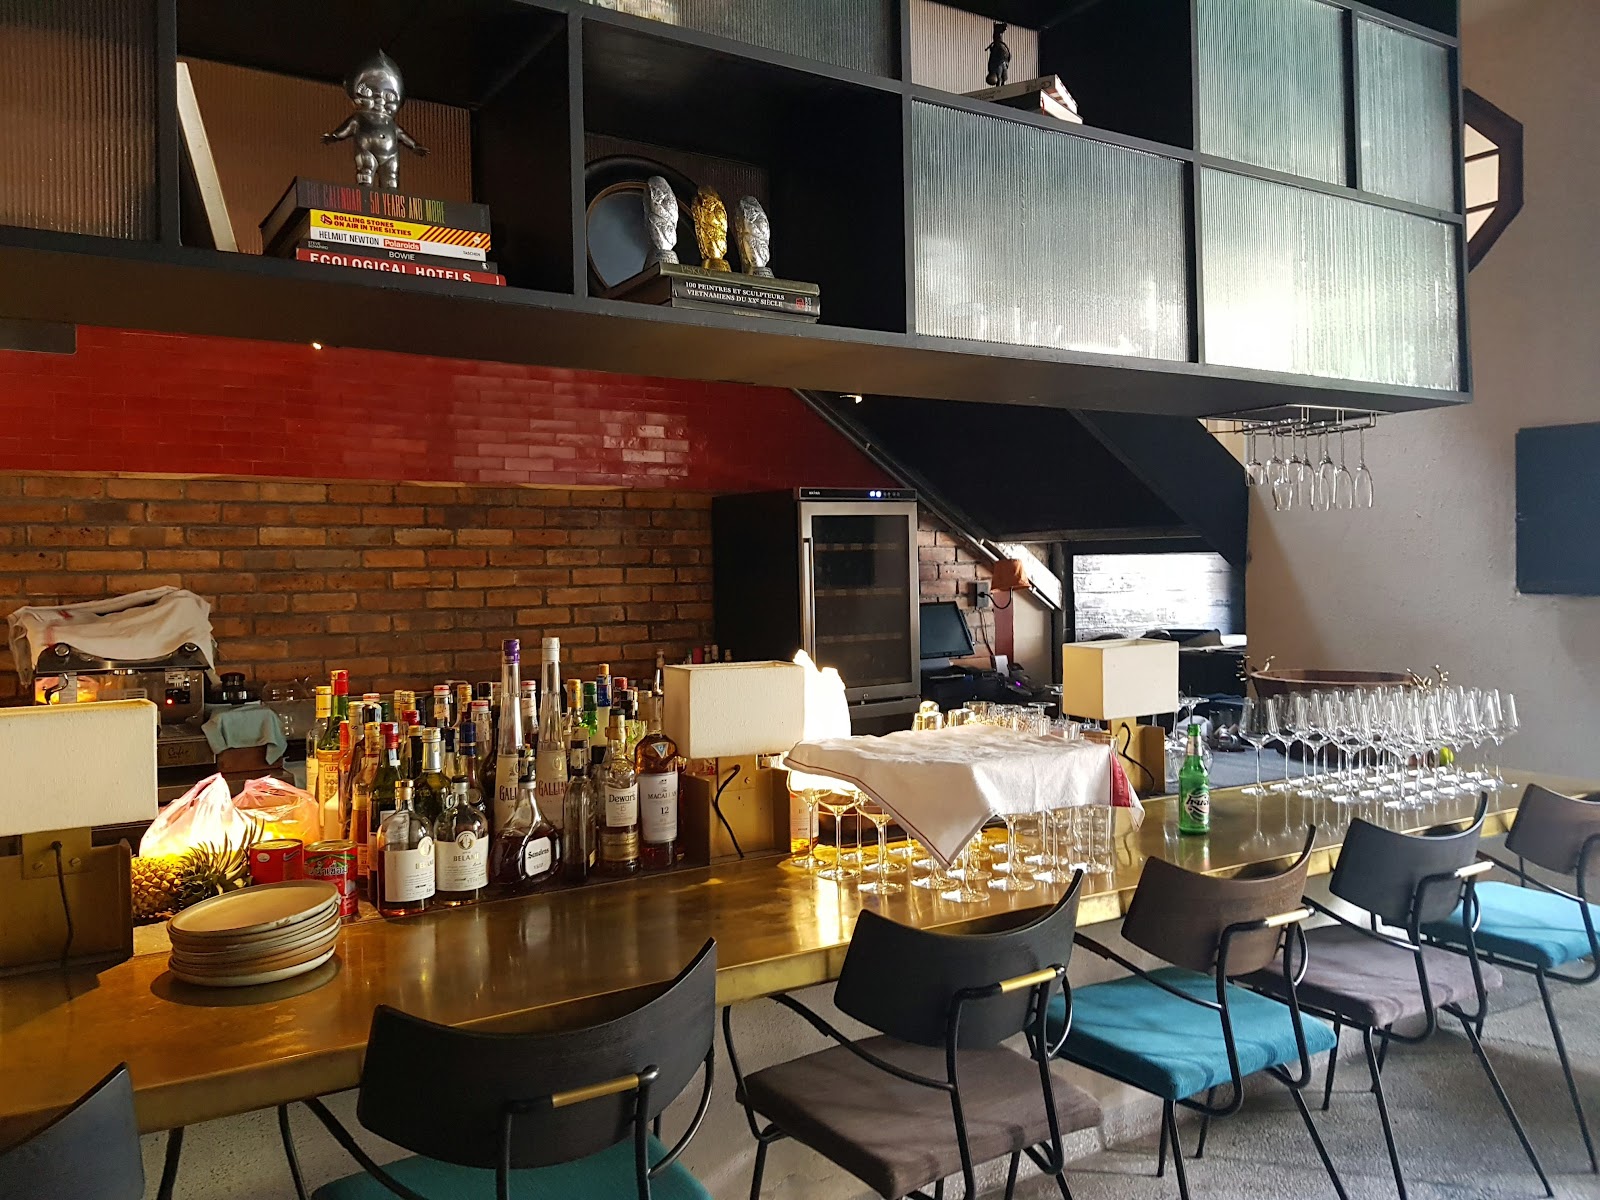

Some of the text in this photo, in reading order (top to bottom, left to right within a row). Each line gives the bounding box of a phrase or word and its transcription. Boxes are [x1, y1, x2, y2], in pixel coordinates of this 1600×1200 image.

[370, 191, 380, 215] 50
[382, 193, 406, 219] YEARS
[408, 197, 423, 221] AND
[425, 199, 445, 224] MORE
[334, 215, 394, 228] ROLLING STONES
[369, 225, 383, 233] THE
[384, 227, 412, 236] SIXTIES
[319, 230, 420, 250] HELMUT NEWTON Polaroids
[388, 251, 415, 260] BOWIE
[685, 281, 697, 289] 100
[697, 283, 732, 293] PEINTRES
[743, 289, 785, 301] SCULPTEURS
[687, 289, 736, 302] VIETNAMIENS
[736, 295, 747, 303] DU
[608, 792, 636, 803] Dewar's
[661, 806, 669, 815] 12
